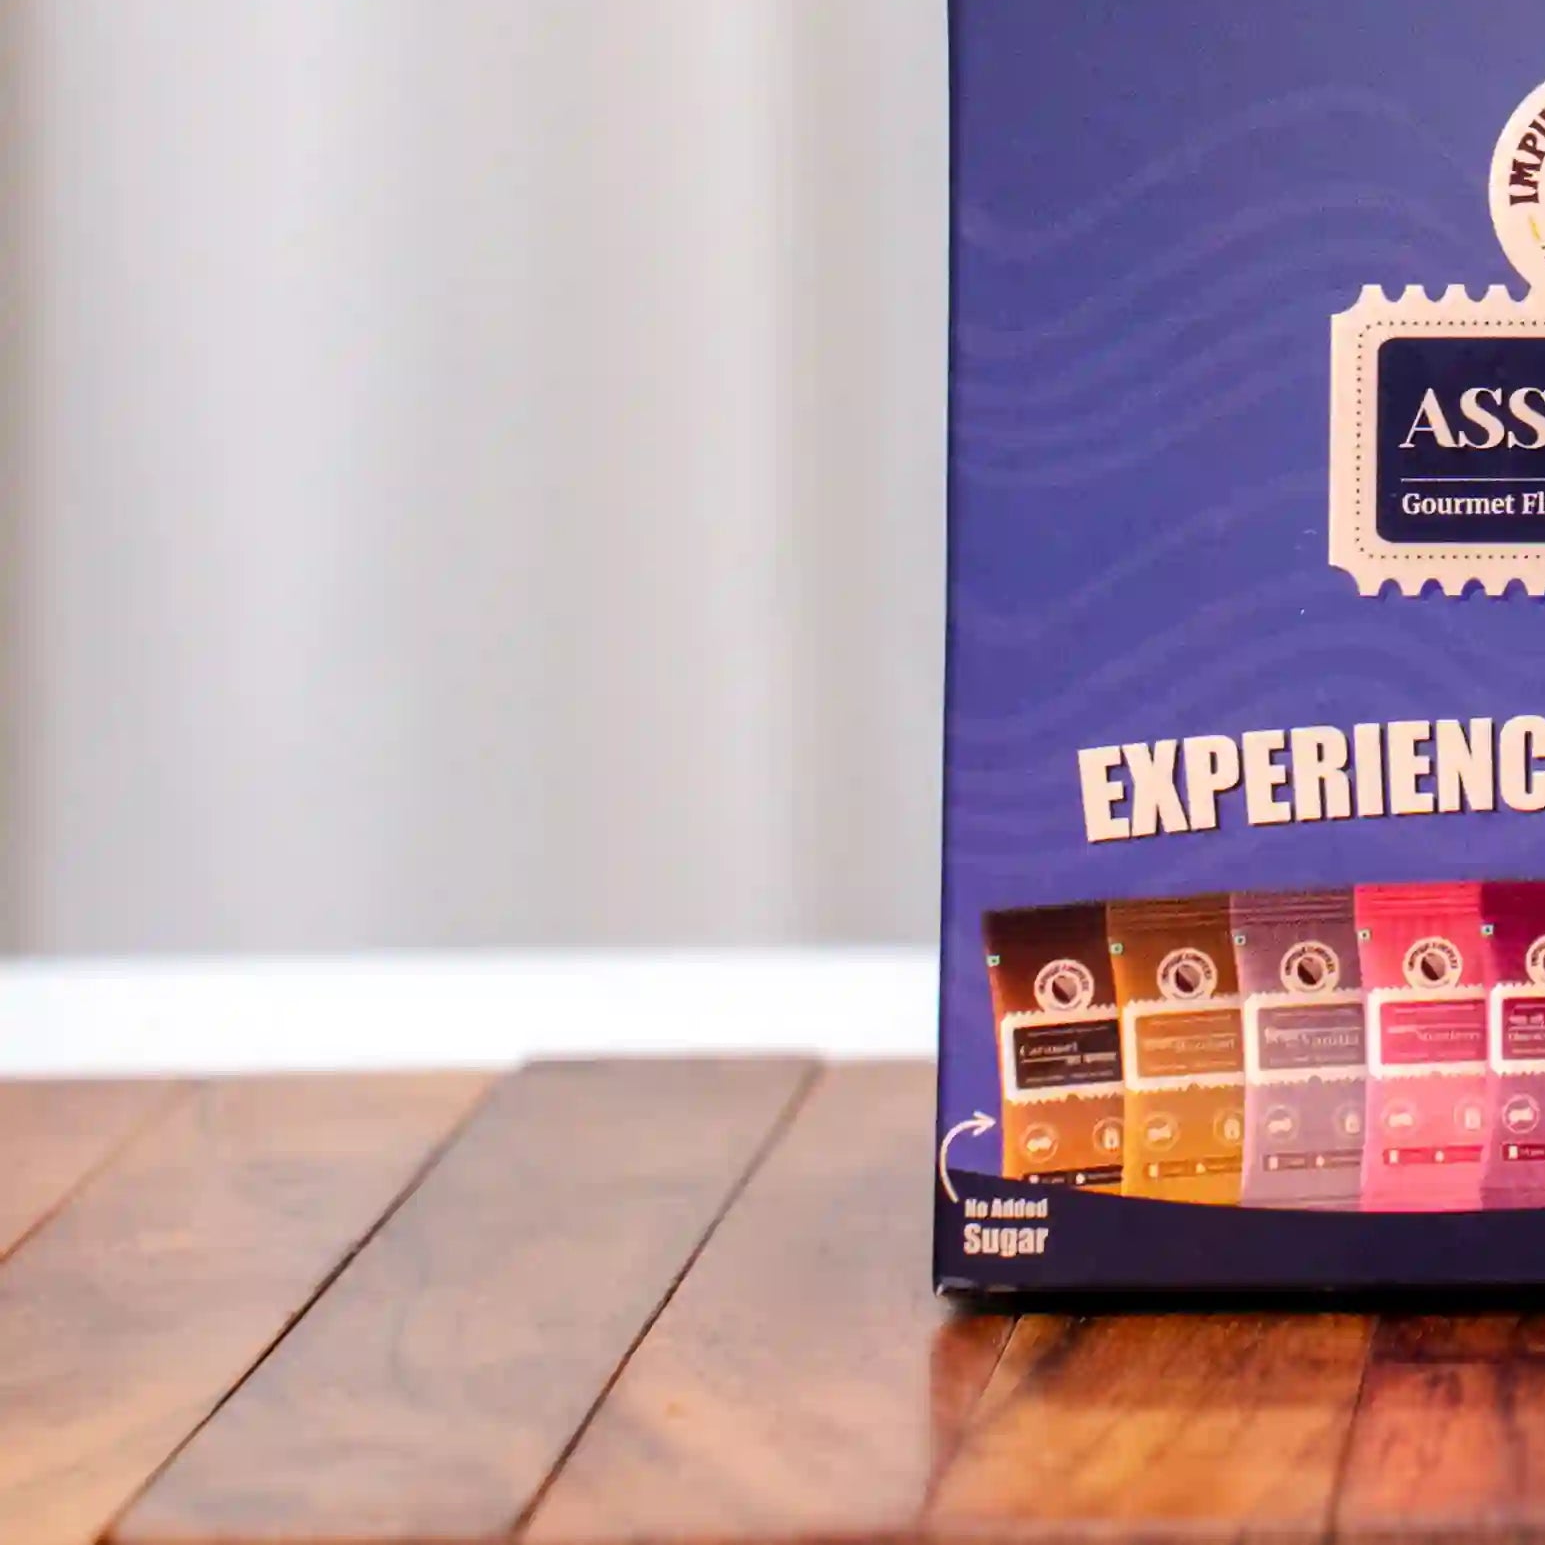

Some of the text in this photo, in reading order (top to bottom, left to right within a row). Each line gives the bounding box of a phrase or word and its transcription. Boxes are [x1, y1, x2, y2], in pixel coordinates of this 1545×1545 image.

[1401, 492, 1515, 516] Gourmet
[965, 1198, 1049, 1220] No Added
[963, 1222, 1049, 1257] Sugar
